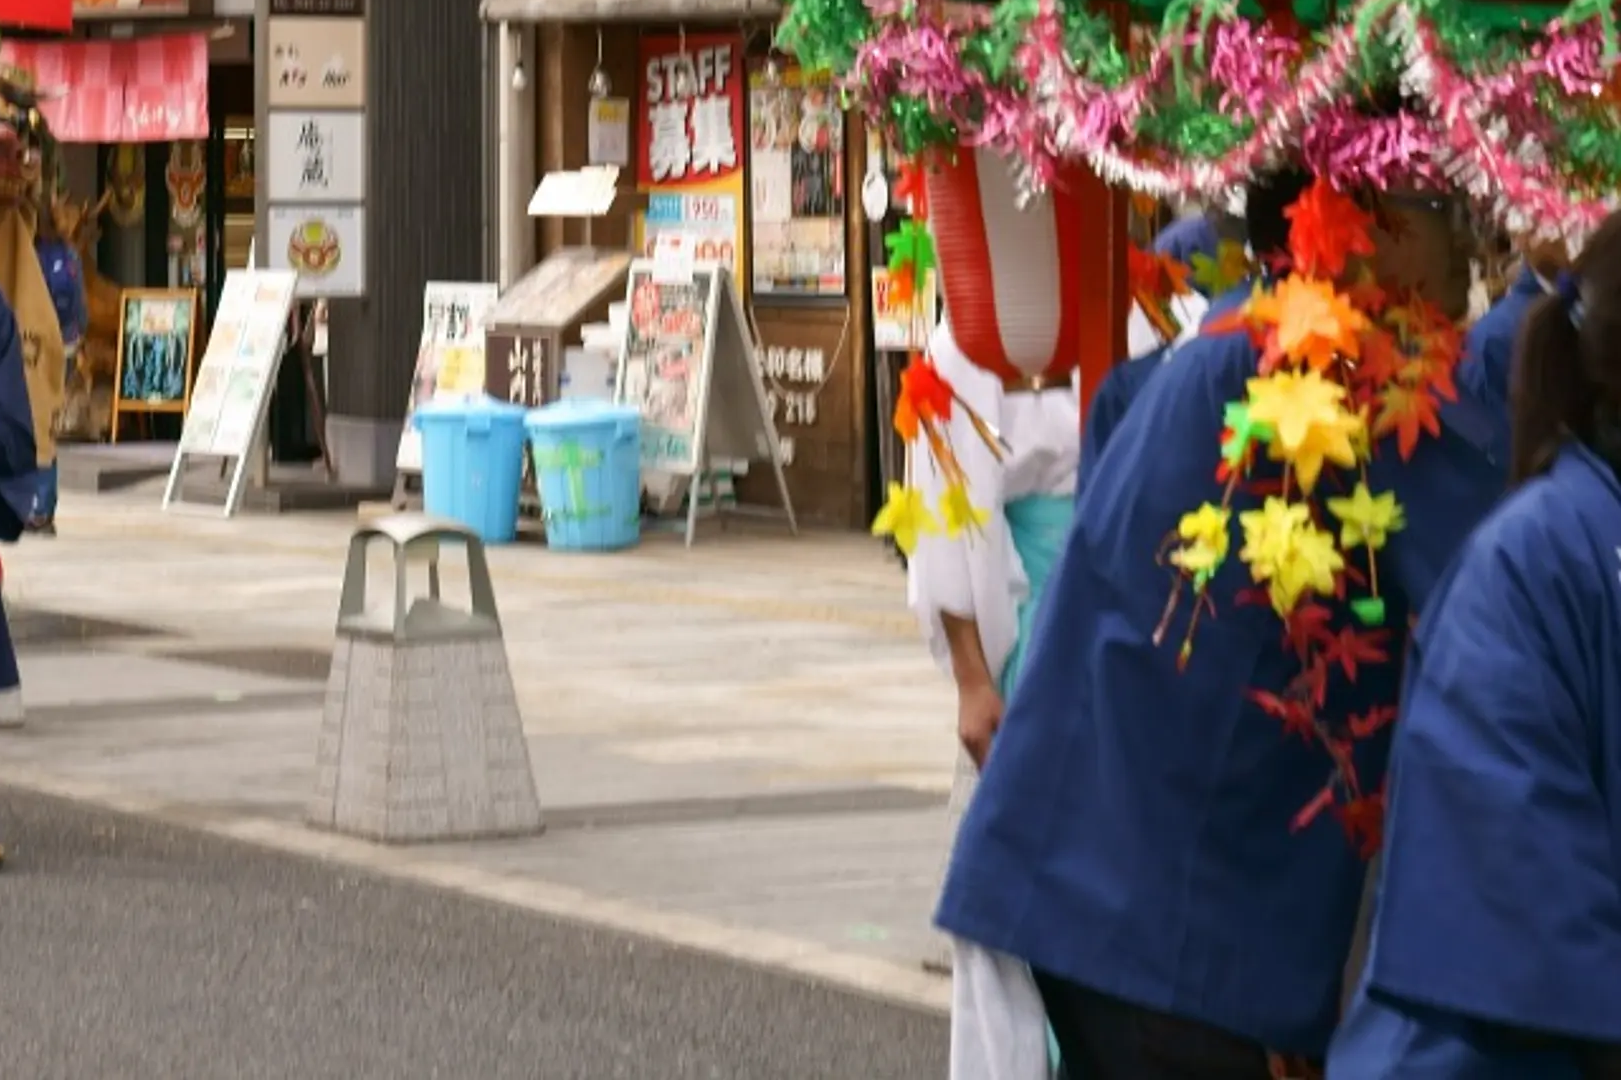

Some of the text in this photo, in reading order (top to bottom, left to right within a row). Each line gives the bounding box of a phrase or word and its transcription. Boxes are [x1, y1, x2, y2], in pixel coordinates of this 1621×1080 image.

[646, 45, 731, 104] STAFF
[647, 93, 738, 183] 募集
[507, 333, 529, 406] 山内
